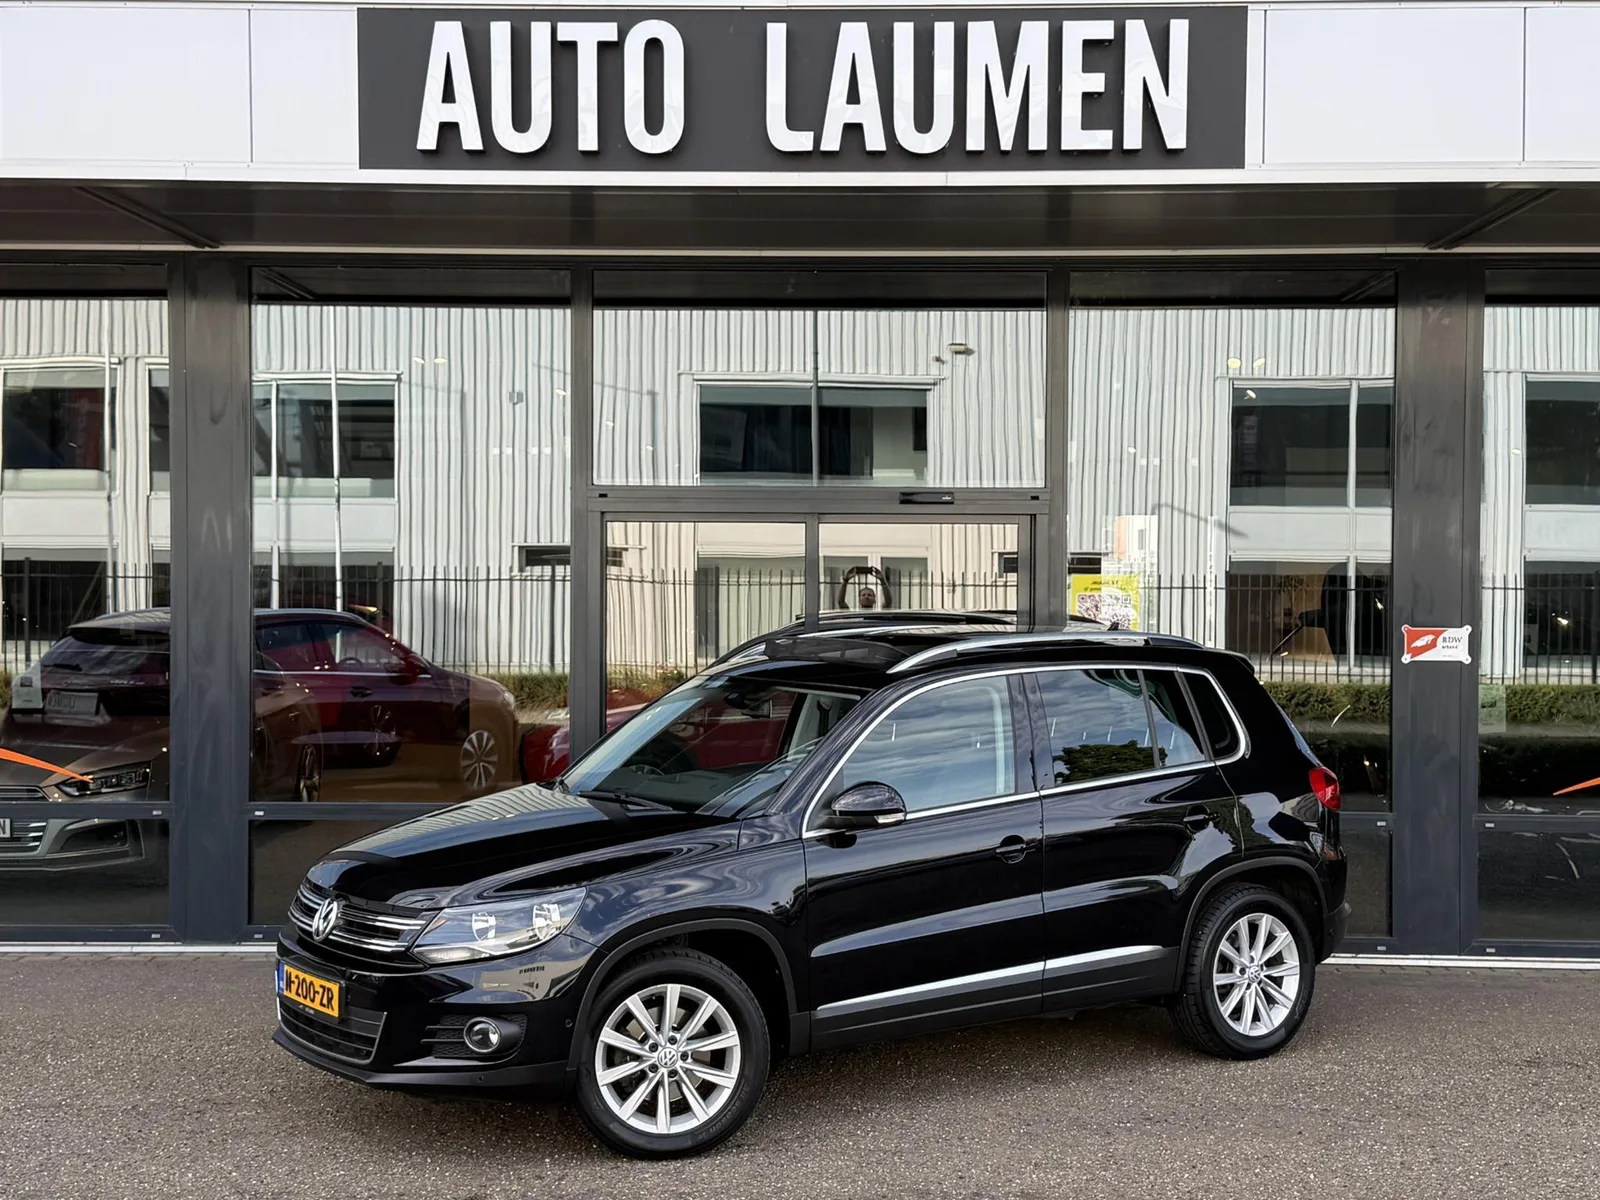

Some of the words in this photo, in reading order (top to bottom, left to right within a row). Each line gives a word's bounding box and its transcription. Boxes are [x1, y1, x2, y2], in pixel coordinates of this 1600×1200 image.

[416, 19, 685, 155] AUTO
[766, 18, 1190, 154] LAUMEN
[285, 968, 335, 1012] N-200-ZR
